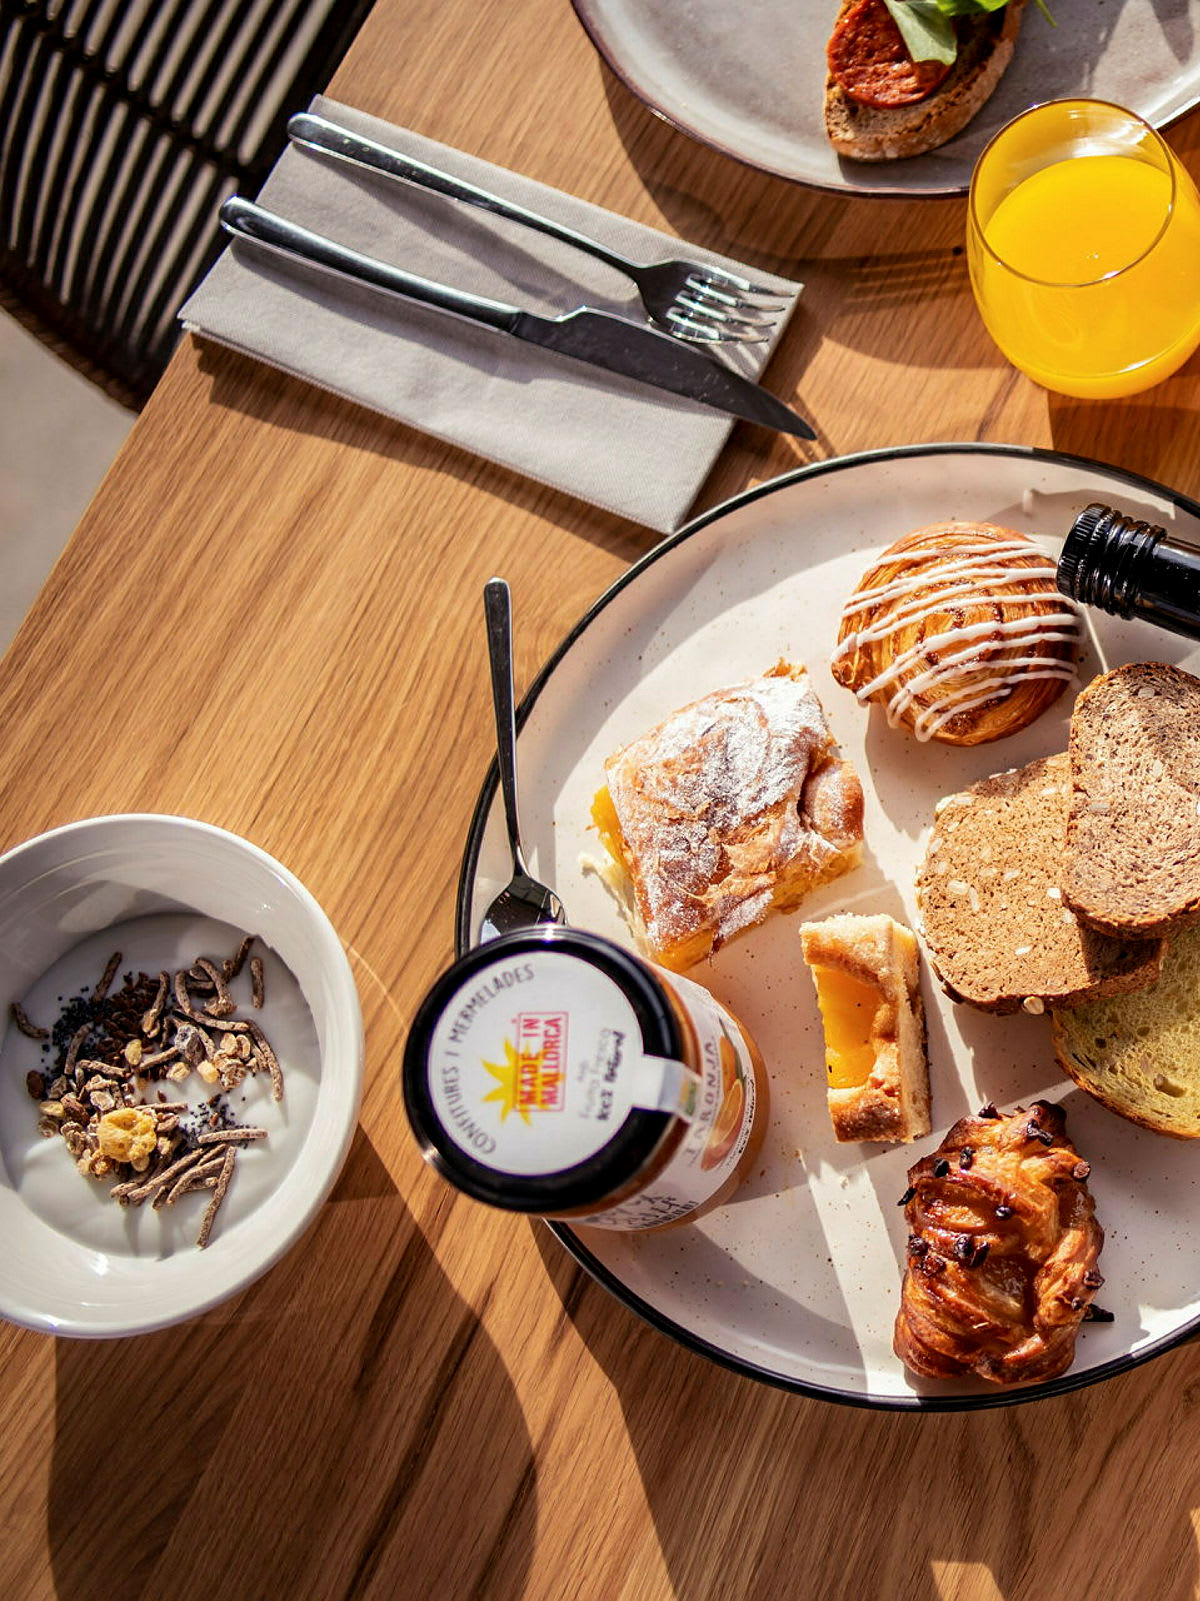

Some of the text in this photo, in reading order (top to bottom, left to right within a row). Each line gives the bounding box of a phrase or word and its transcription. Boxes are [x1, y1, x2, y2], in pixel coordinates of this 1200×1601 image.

[449, 963, 535, 1043] MERMELADES
[519, 1018, 541, 1106] MADE IN
[540, 1016, 563, 1105] MALLORCA
[442, 1066, 497, 1155] CONFITURES
